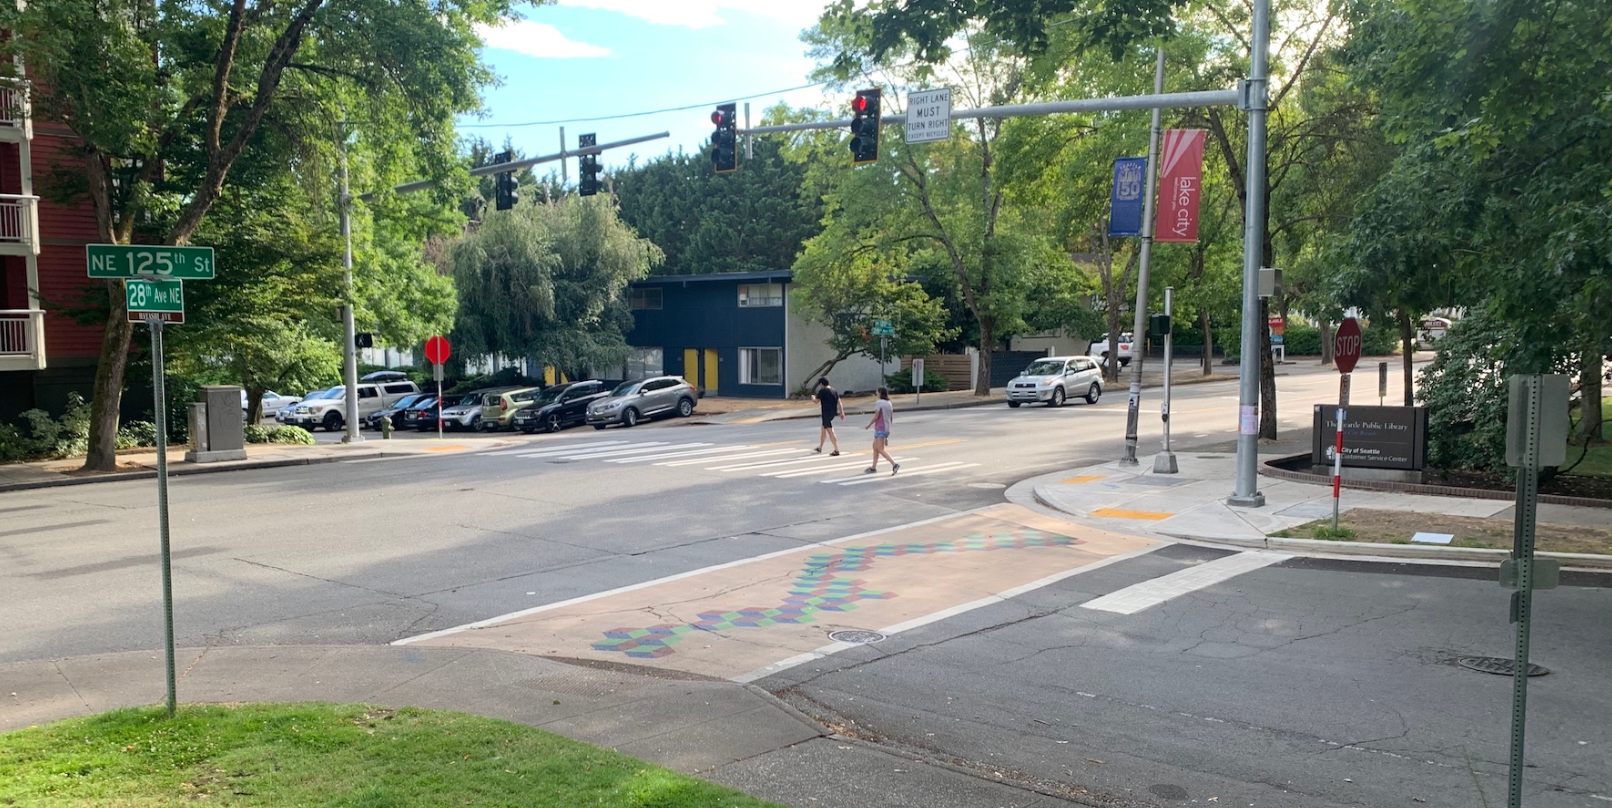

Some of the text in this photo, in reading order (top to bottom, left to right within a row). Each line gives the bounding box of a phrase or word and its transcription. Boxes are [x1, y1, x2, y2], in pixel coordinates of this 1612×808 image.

[910, 92, 948, 105] RIGHT LANE
[917, 106, 940, 118] MUST
[908, 119, 948, 131] TURN RIGHT
[1172, 177, 1196, 237] lake city
[92, 251, 210, 275] NE 125th St
[128, 283, 181, 307] 28th Ave NE
[1336, 335, 1359, 357] STOP
[1362, 421, 1382, 430] Public
[1384, 422, 1408, 431] Library
